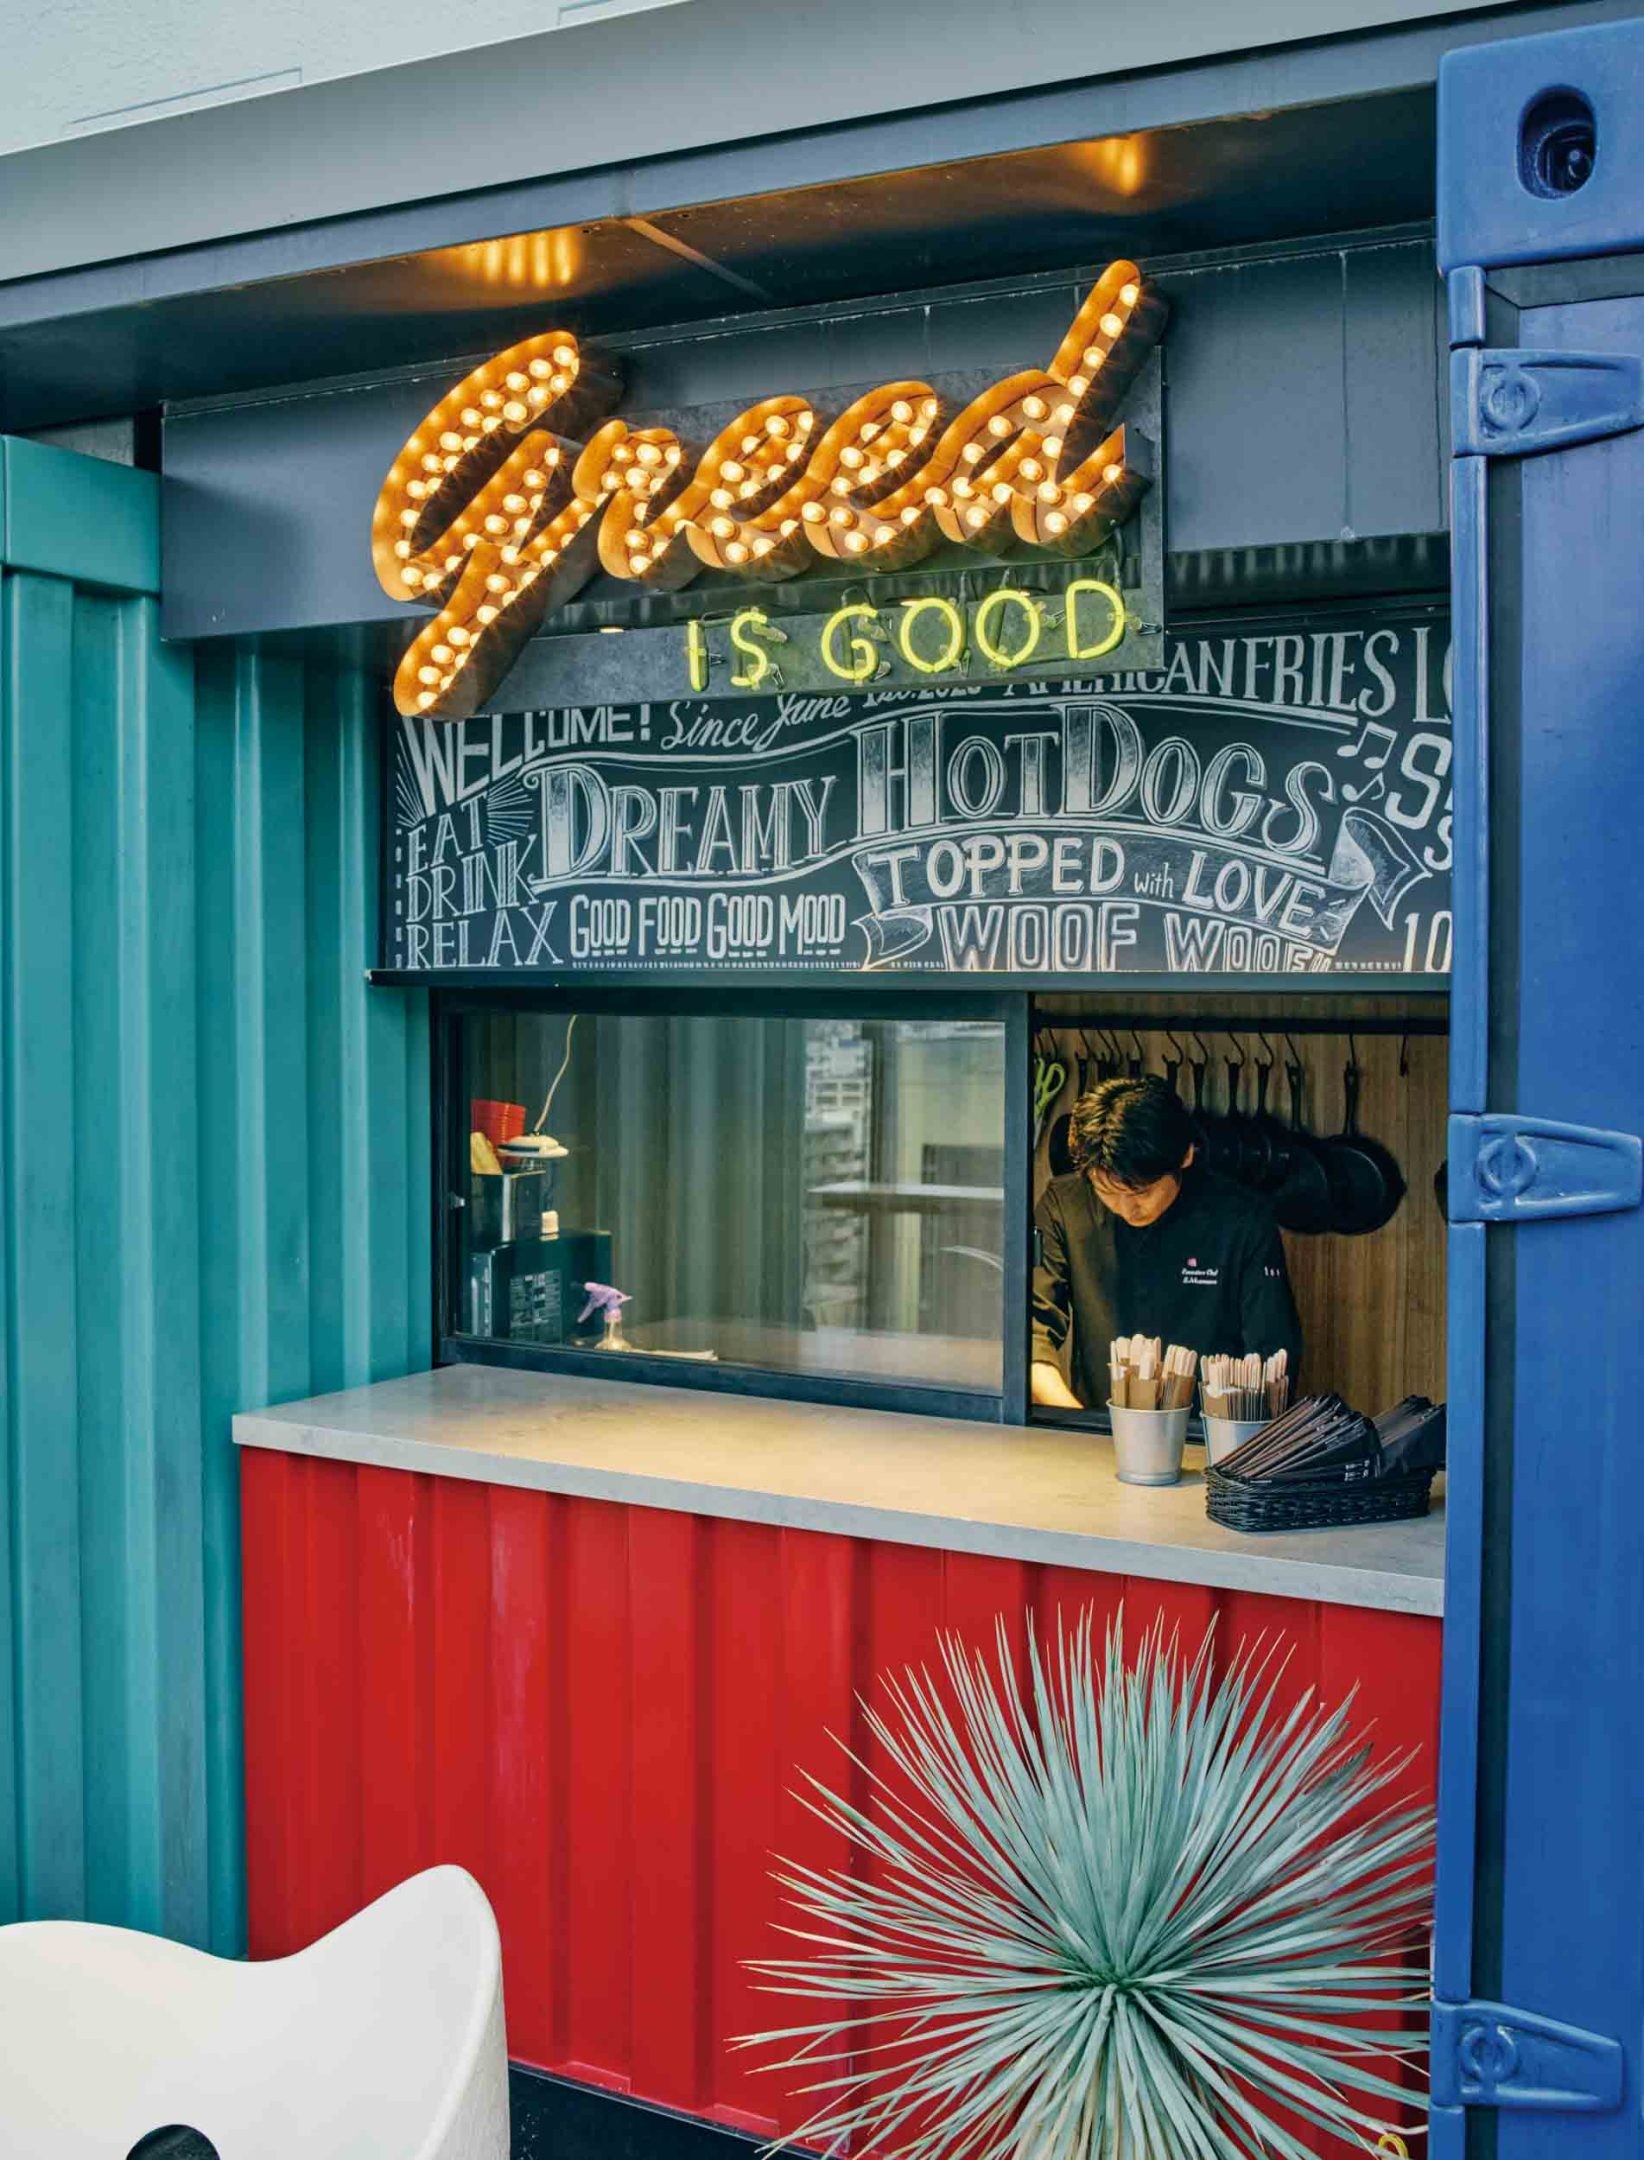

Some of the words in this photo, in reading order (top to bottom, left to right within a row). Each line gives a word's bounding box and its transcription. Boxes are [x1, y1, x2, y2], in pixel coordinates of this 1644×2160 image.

[686, 611, 768, 691] IS
[821, 579, 1126, 681] GOOD
[1240, 627, 1399, 717] FRIES
[1412, 626, 1452, 723] L
[661, 701, 758, 750] Since
[407, 790, 488, 876] EAT
[524, 763, 837, 882] DREAMY
[405, 833, 540, 923] DRINK
[869, 834, 1126, 908] TOPPED
[1132, 861, 1175, 900] with
[1182, 850, 1327, 940] LOVE
[406, 900, 565, 970] RELAX
[570, 893, 630, 958] GOOD
[638, 894, 701, 956] FOOD
[707, 892, 774, 958] GOOD
[779, 892, 847, 956] MOOD
[936, 902, 1140, 971] WOOF
